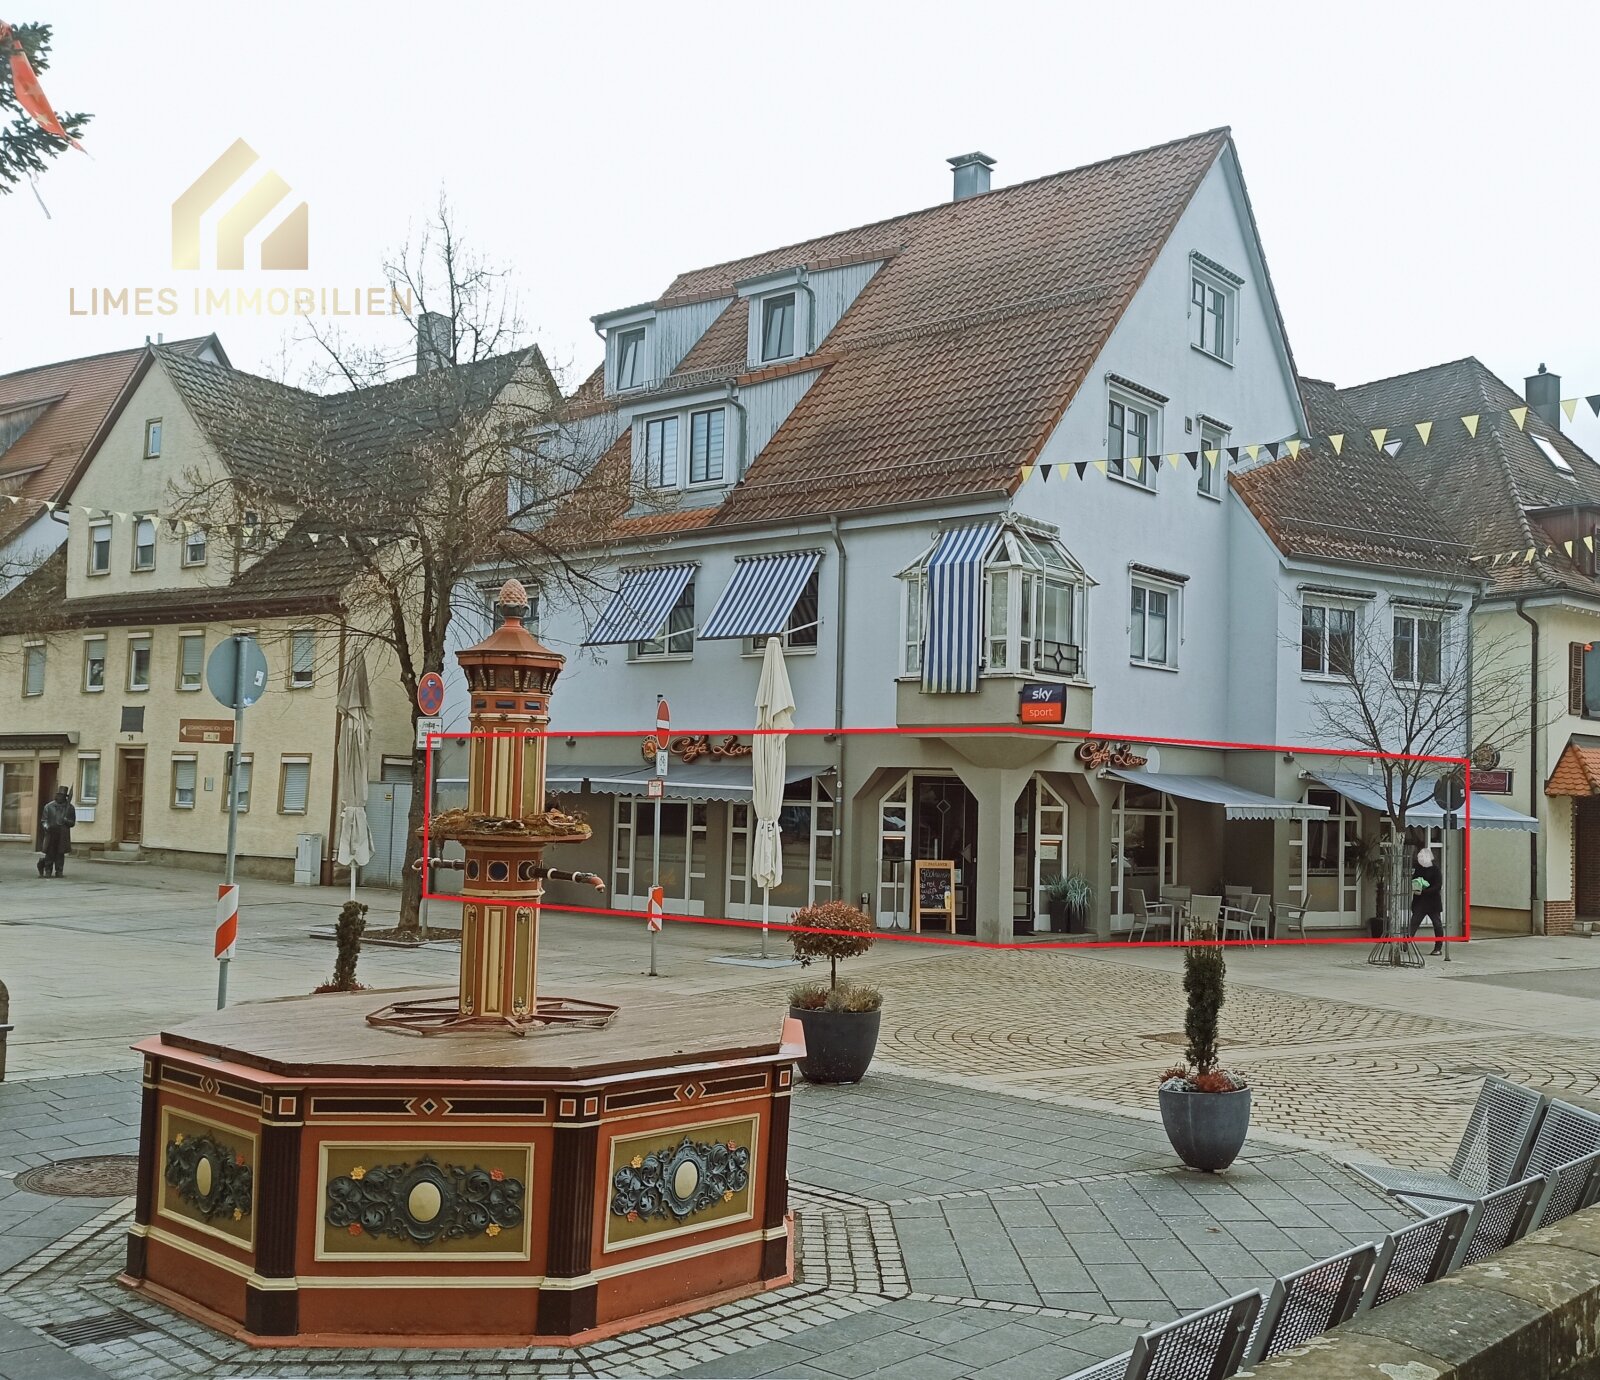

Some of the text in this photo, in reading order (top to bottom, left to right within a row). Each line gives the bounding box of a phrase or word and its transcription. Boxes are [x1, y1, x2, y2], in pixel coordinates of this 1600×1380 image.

[1031, 687, 1053, 702] sky
[1029, 708, 1054, 718] sport
[670, 734, 709, 762] Café
[712, 735, 753, 757] Lion
[1079, 741, 1148, 770] Café Lion
